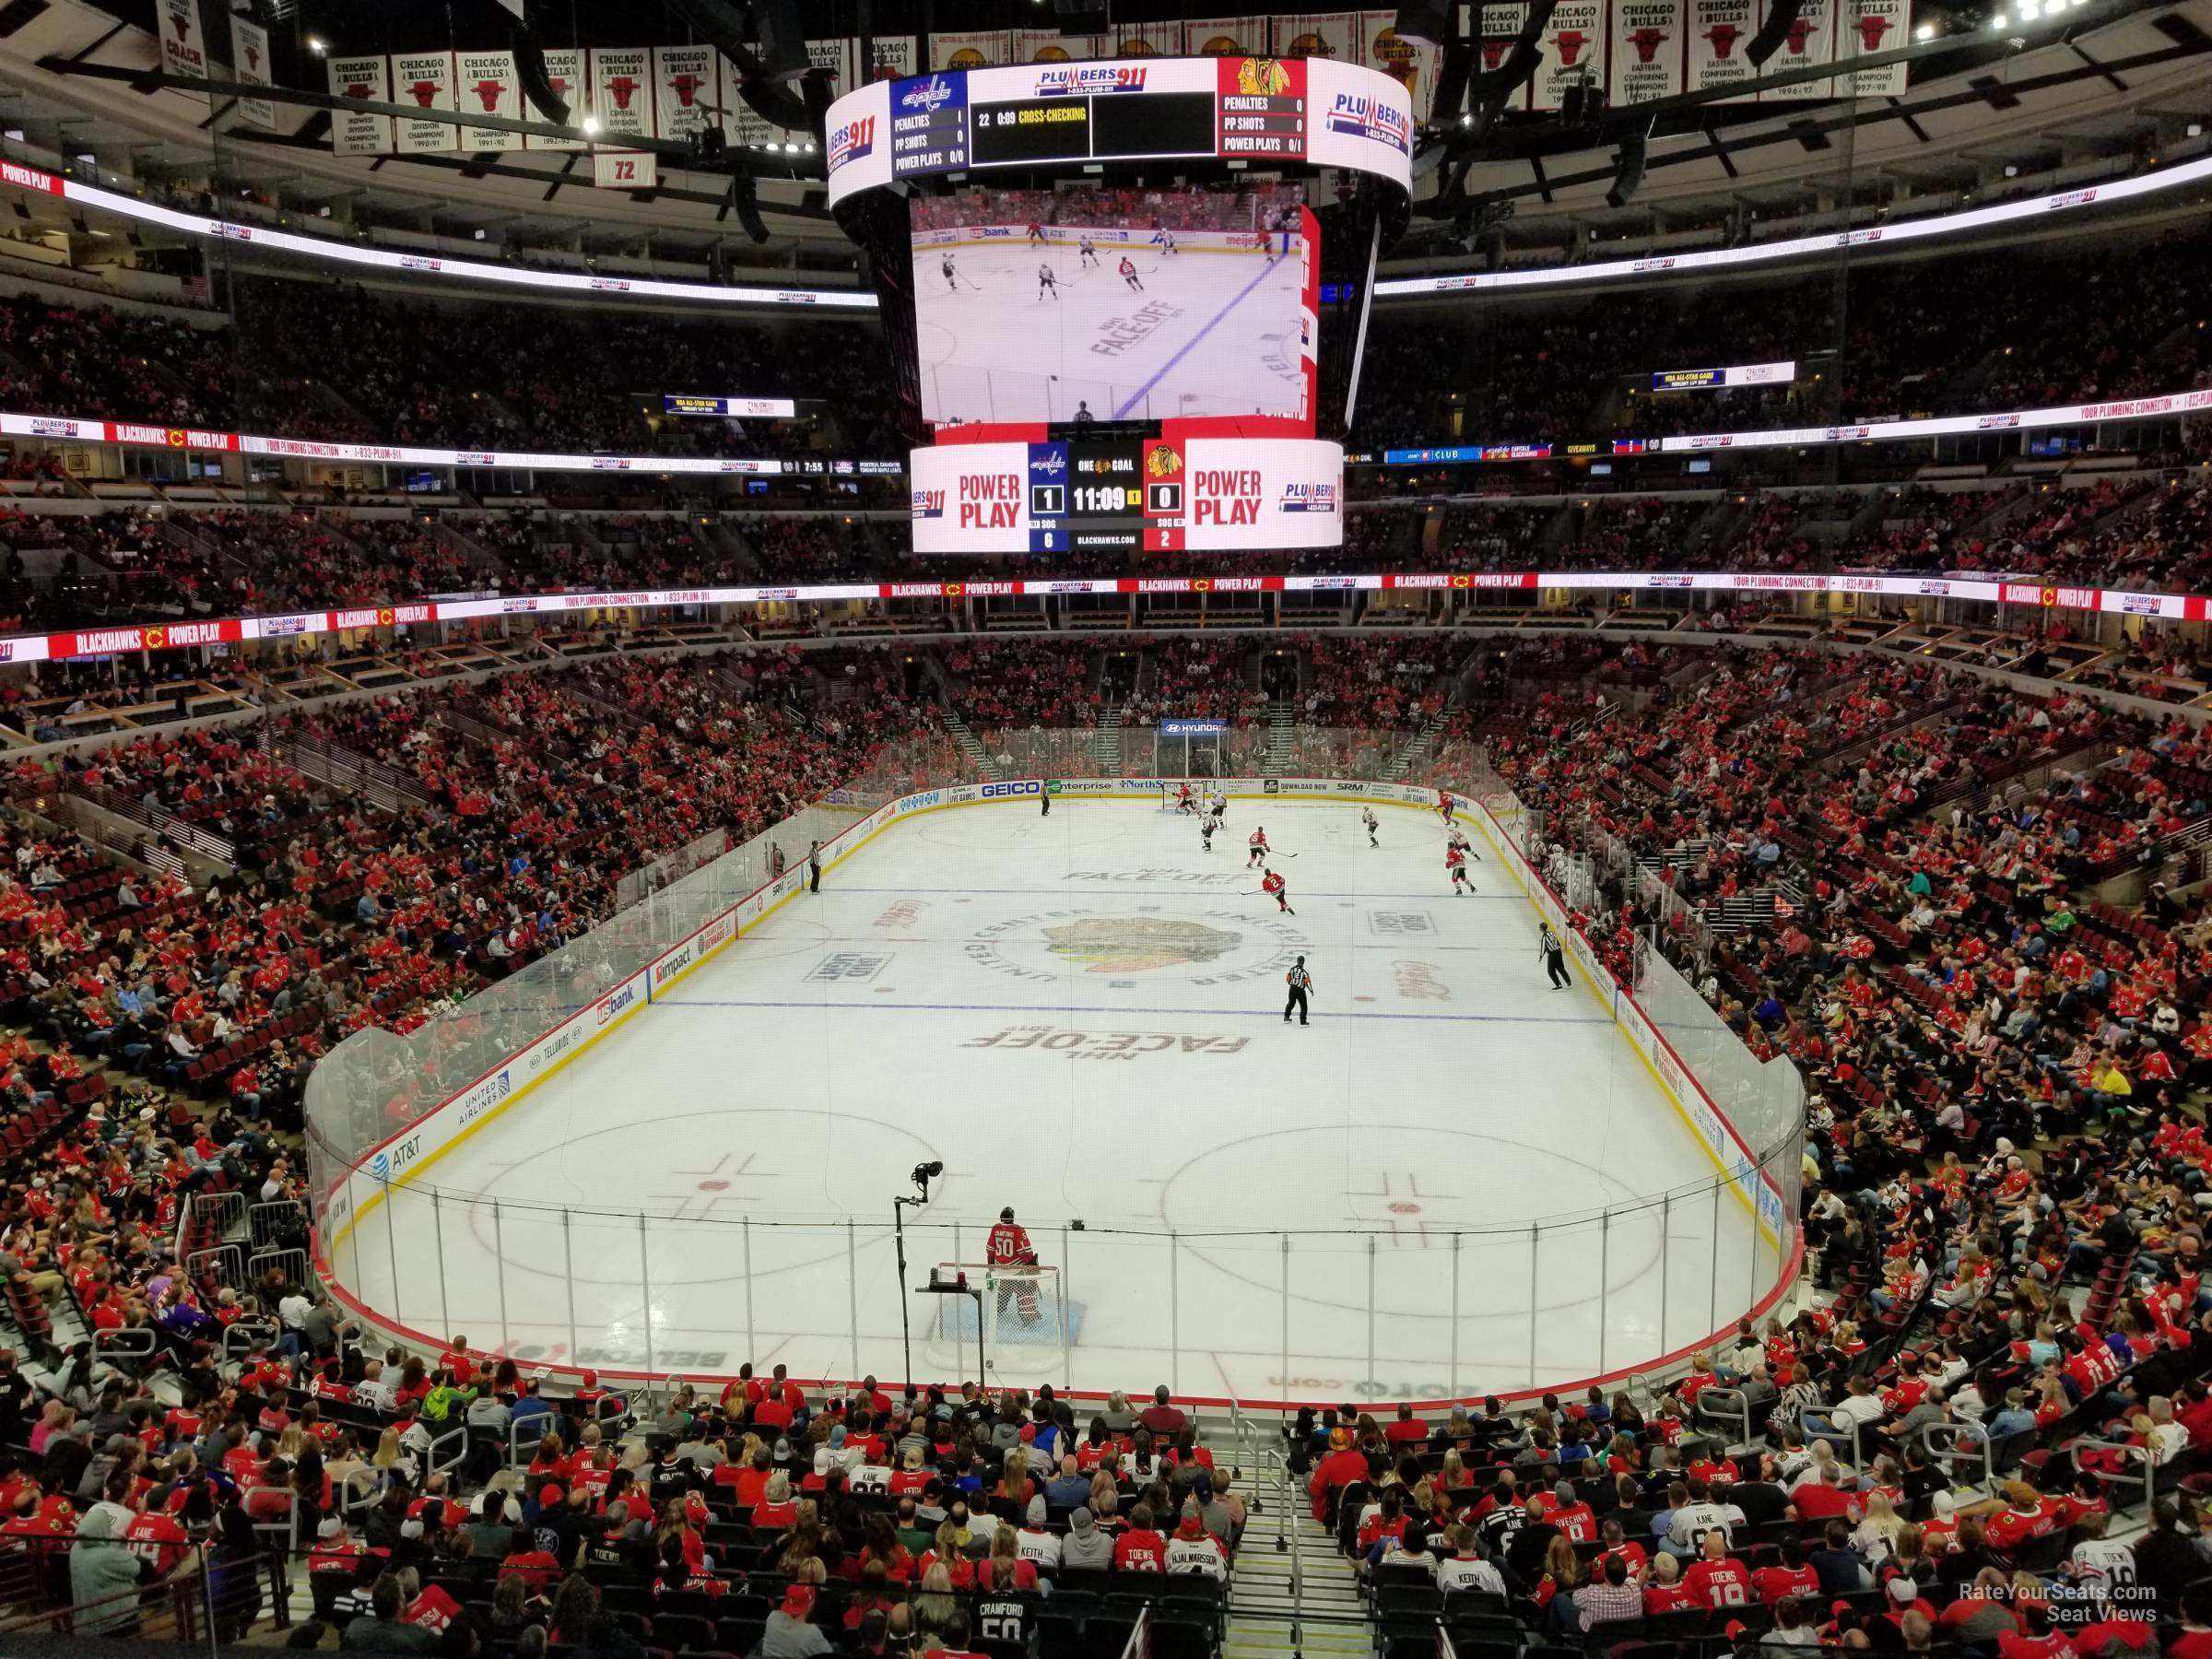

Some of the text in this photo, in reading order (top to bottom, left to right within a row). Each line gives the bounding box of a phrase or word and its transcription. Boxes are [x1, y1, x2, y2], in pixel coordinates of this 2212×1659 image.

[1623, 5, 1675, 16] CHICAGO
[1706, 12, 1742, 22] BULLS
[1552, 18, 1588, 29] BULLS
[1631, 17, 1667, 27] BULLS
[465, 58, 510, 68] CHICAGO
[599, 54, 643, 65] CHICAGO
[662, 51, 707, 62] CHICAGO
[1707, 59, 1738, 67] EASTERN
[335, 62, 379, 72] CHICAGO
[399, 59, 444, 69] CHICAGO
[606, 65, 638, 75] BULLS
[671, 64, 702, 74] BULLS
[342, 73, 373, 83] BULLS
[408, 70, 440, 80] BULLS
[473, 69, 505, 78] BULLS
[1117, 67, 1147, 87] 911
[1624, 73, 1669, 82] CONFERENCE
[1700, 69, 1746, 78] CONFERENCE
[1224, 97, 1302, 112] PENALTIES 0
[895, 114, 930, 132] PENALTIES
[979, 107, 1087, 127] 22 0:09 CROSS-CHECKING
[1224, 117, 1302, 132] PP SHOTS 0
[849, 114, 875, 150] 911
[895, 130, 963, 151] PP SHOTS 0
[1224, 137, 1301, 152] POWER PLAYS 0/1
[896, 150, 963, 171] POWER PLAYS 0/0
[616, 160, 635, 179] 72
[2, 162, 52, 192] POWER PLAY
[2081, 397, 2172, 419] YOUR PLUMBING CONNECTION
[66, 422, 78, 434] 911
[117, 424, 229, 450] BLACKHAWKS POWER PLAY
[266, 438, 402, 460] YOUR PLUMBING CONNECTION 1-833-PLUM-911
[1435, 449, 1458, 459] CLUB
[1568, 444, 1595, 453] GIVEAWAYS
[805, 462, 823, 472] 7:55
[1078, 459, 1134, 472] ONE GOAL
[959, 474, 1020, 500] POWER
[1194, 471, 1262, 497] POWER
[925, 489, 945, 510] 911
[1043, 487, 1171, 511] 1 11:09 0
[960, 502, 1021, 529] PLAY
[1194, 499, 1263, 525] PLAY
[1041, 519, 1056, 529] SOG
[1157, 518, 1172, 528] SOG
[1044, 531, 1170, 547] 6 BLACKHAWKS.COM 2
[1138, 578, 1263, 591] BLACKHAWKS POWER PLAY
[1394, 575, 1523, 587] BLACKHAWKS POWER PLAY
[1733, 576, 1883, 591] YOUR PLUMBING CONNECTION 1-833-PLUM-911
[892, 582, 1013, 595] BLACKHAWKS POWER PLAY
[564, 591, 711, 607] YOUR PLUMBING CONNECTION 1-833-PLUM-911
[2006, 585, 2093, 607] BLACKHAWKS POWER PLAY
[336, 606, 429, 627] BLACKHAWKS POWER PLAY
[76, 622, 220, 654] BLACKHAWKS POWER PLAY
[1182, 724, 1222, 733] HYUNDAI
[982, 782, 1040, 797] GEICO
[1049, 782, 1112, 793] enterprise
[1336, 782, 1364, 791] SRM
[1402, 794, 1412, 803] LIVE
[1271, 878, 1279, 888] 2
[663, 945, 691, 981] impact
[544, 1032, 570, 1061] TELLURIDE
[1065, 1051, 1139, 1061] NHL
[465, 1082, 496, 1108] UNITED
[459, 1092, 497, 1126] AIRLINES
[393, 1135, 421, 1171] AT&T
[994, 1239, 1014, 1257] 50
[576, 1348, 729, 1368] BELFOR
[863, 1472, 878, 1482] KANE
[1710, 1473, 1734, 1483] STROME
[1555, 1512, 1589, 1528] OVECHKIN
[1696, 1514, 1715, 1525] KANE
[594, 1548, 619, 1562] TOEWS
[1022, 1547, 1043, 1559] KEITH
[1128, 1549, 1153, 1560] TOEWS
[1171, 1553, 1217, 1566] HJALMARSSON
[1458, 1573, 1480, 1584] KEITH
[1709, 1571, 1736, 1584] TOEWS
[980, 1603, 1023, 1617] CRAWFORD
